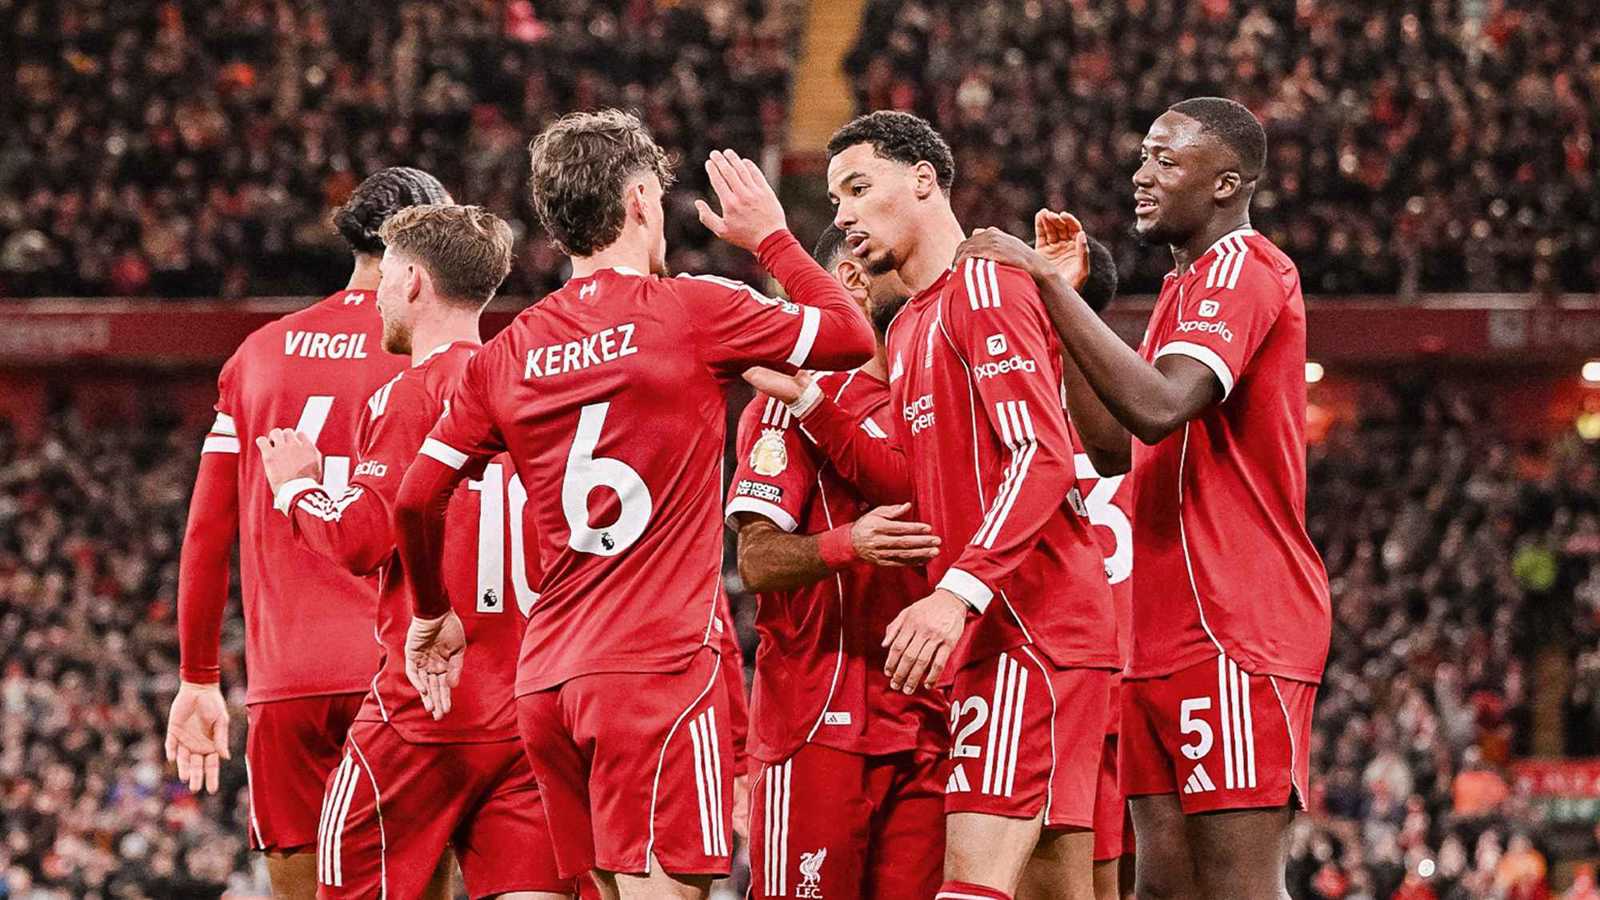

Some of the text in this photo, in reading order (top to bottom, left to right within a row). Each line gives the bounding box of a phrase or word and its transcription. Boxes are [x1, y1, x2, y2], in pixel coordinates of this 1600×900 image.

[284, 331, 368, 359] VIRGIL
[524, 323, 638, 380] KERKEZ
[1175, 320, 1233, 343] xpedia
[562, 402, 652, 557] 6
[752, 482, 780, 496] room
[1180, 697, 1213, 760] 5
